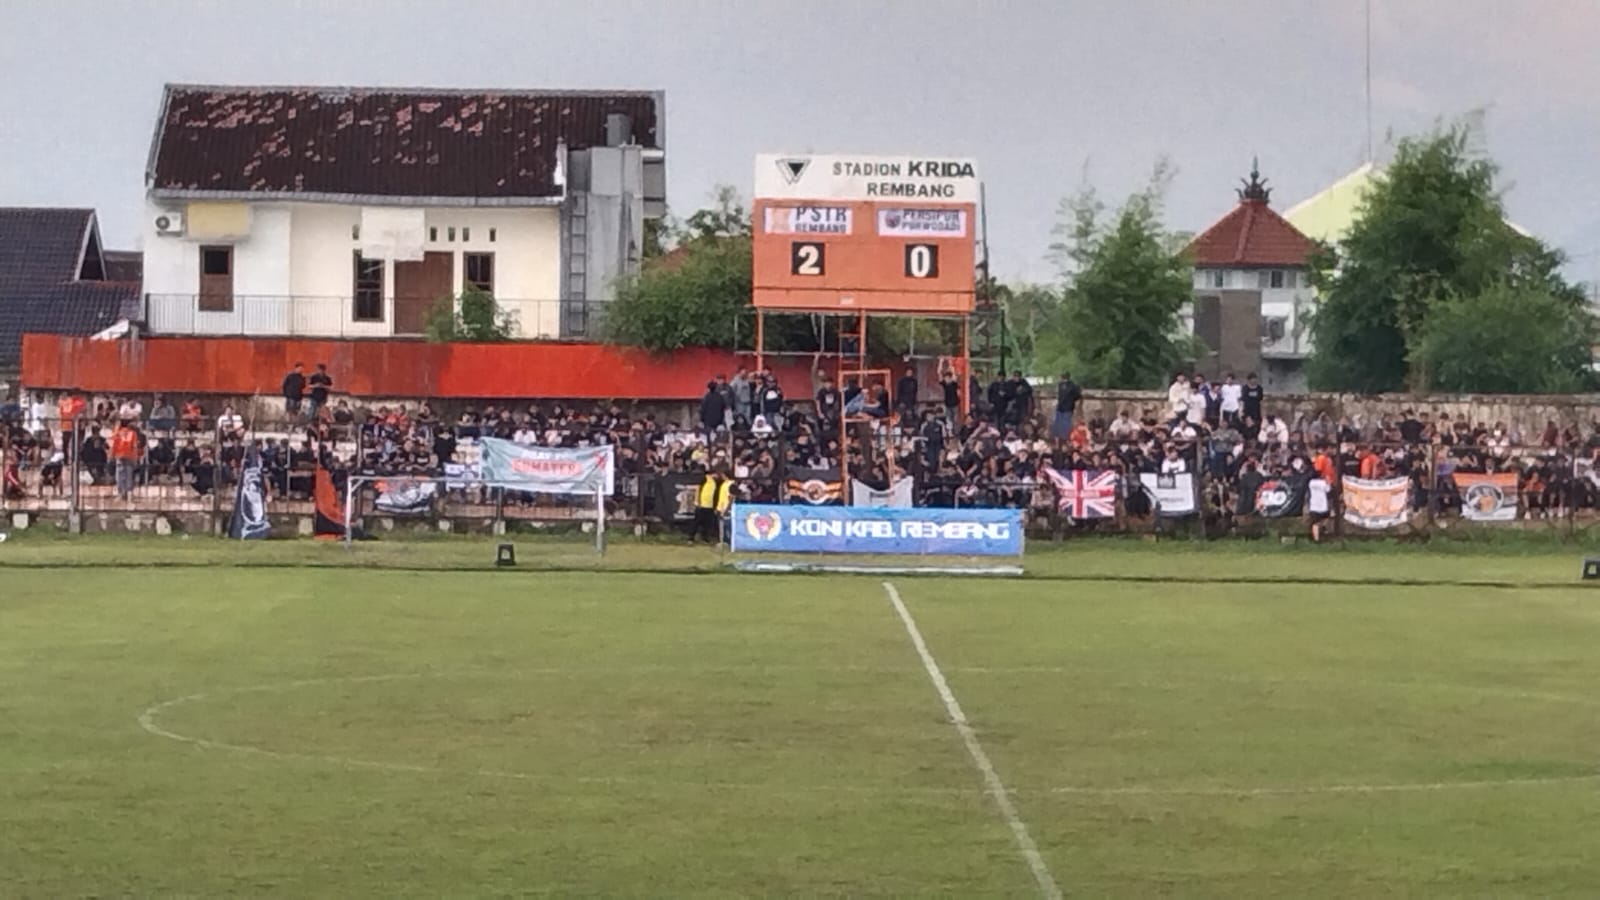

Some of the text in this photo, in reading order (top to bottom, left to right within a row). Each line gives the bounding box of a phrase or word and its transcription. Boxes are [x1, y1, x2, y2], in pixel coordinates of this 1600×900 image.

[833, 161, 975, 178] STADION KRIDA
[867, 183, 955, 198] REMBANG
[796, 207, 847, 222] PSTR
[798, 245, 821, 275] 2
[910, 246, 931, 278] 0
[790, 518, 842, 536] KONI
[901, 521, 1010, 540] REMBANG
